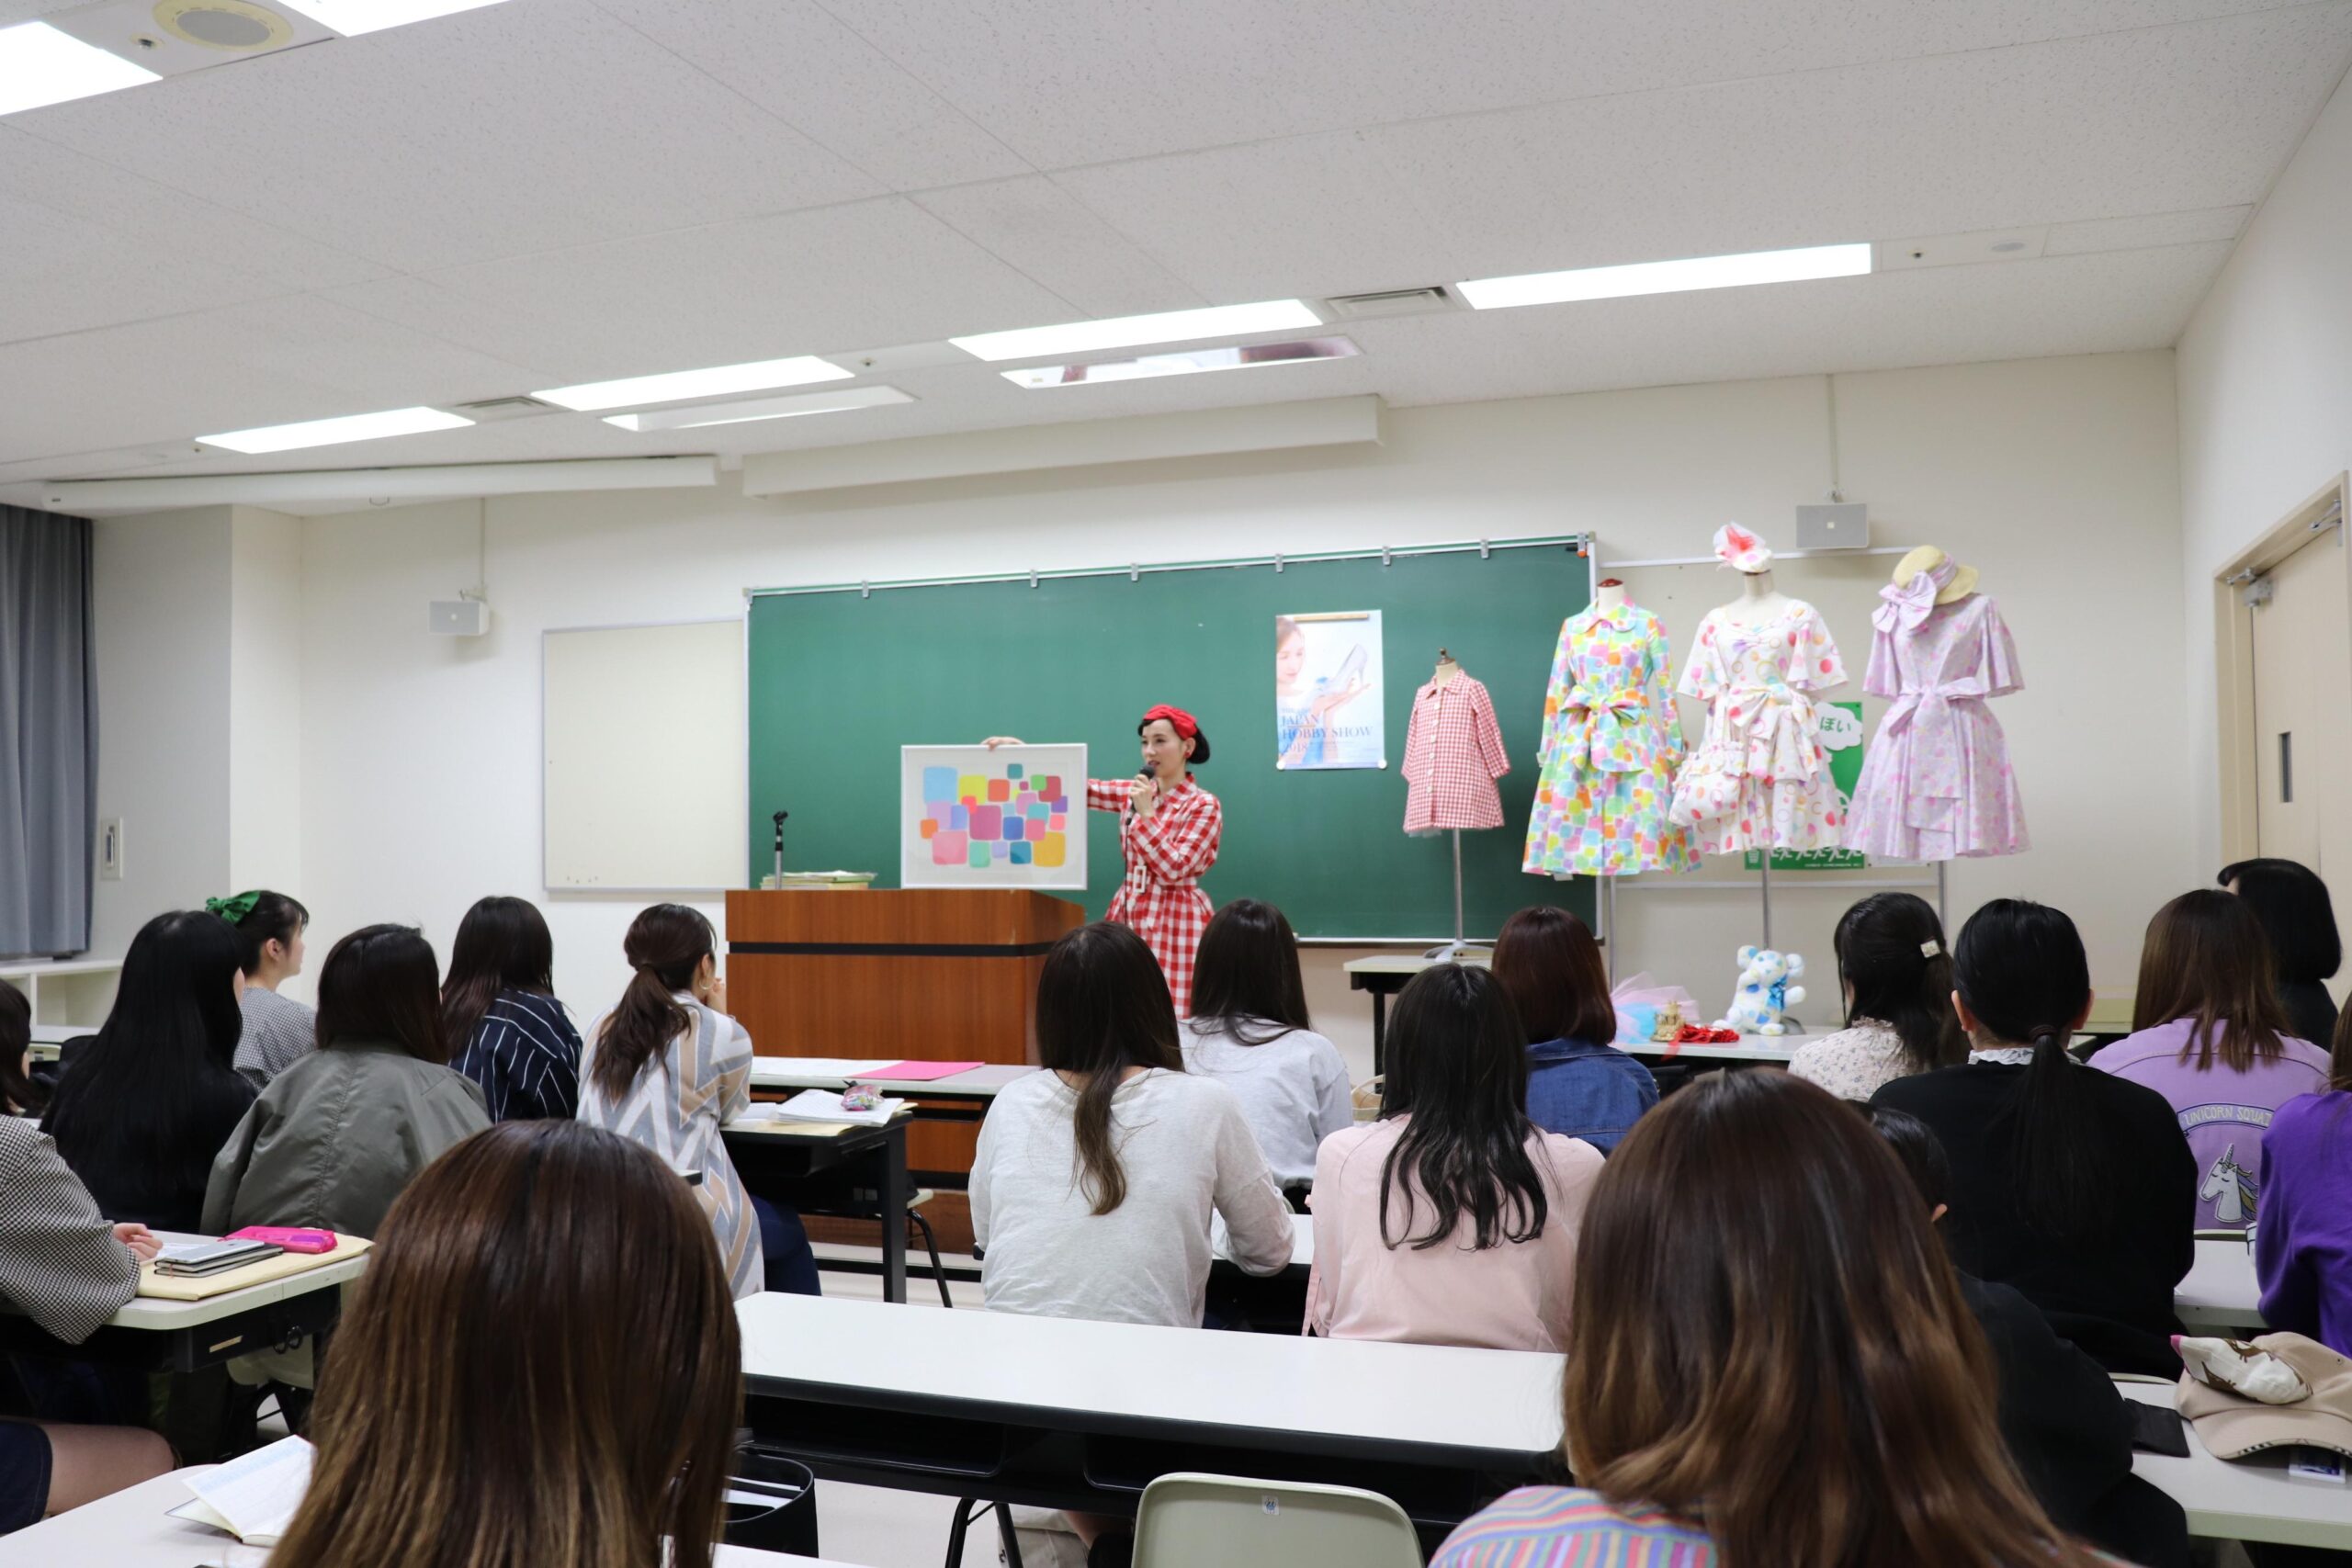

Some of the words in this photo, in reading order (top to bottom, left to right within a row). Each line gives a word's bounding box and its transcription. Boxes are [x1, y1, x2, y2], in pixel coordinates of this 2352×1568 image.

[1280, 714, 1319, 727] JAPAN
[1281, 727, 1328, 739] HOBBY
[1331, 726, 1374, 738] SHOW
[2182, 1105, 2233, 1126] UNICORN
